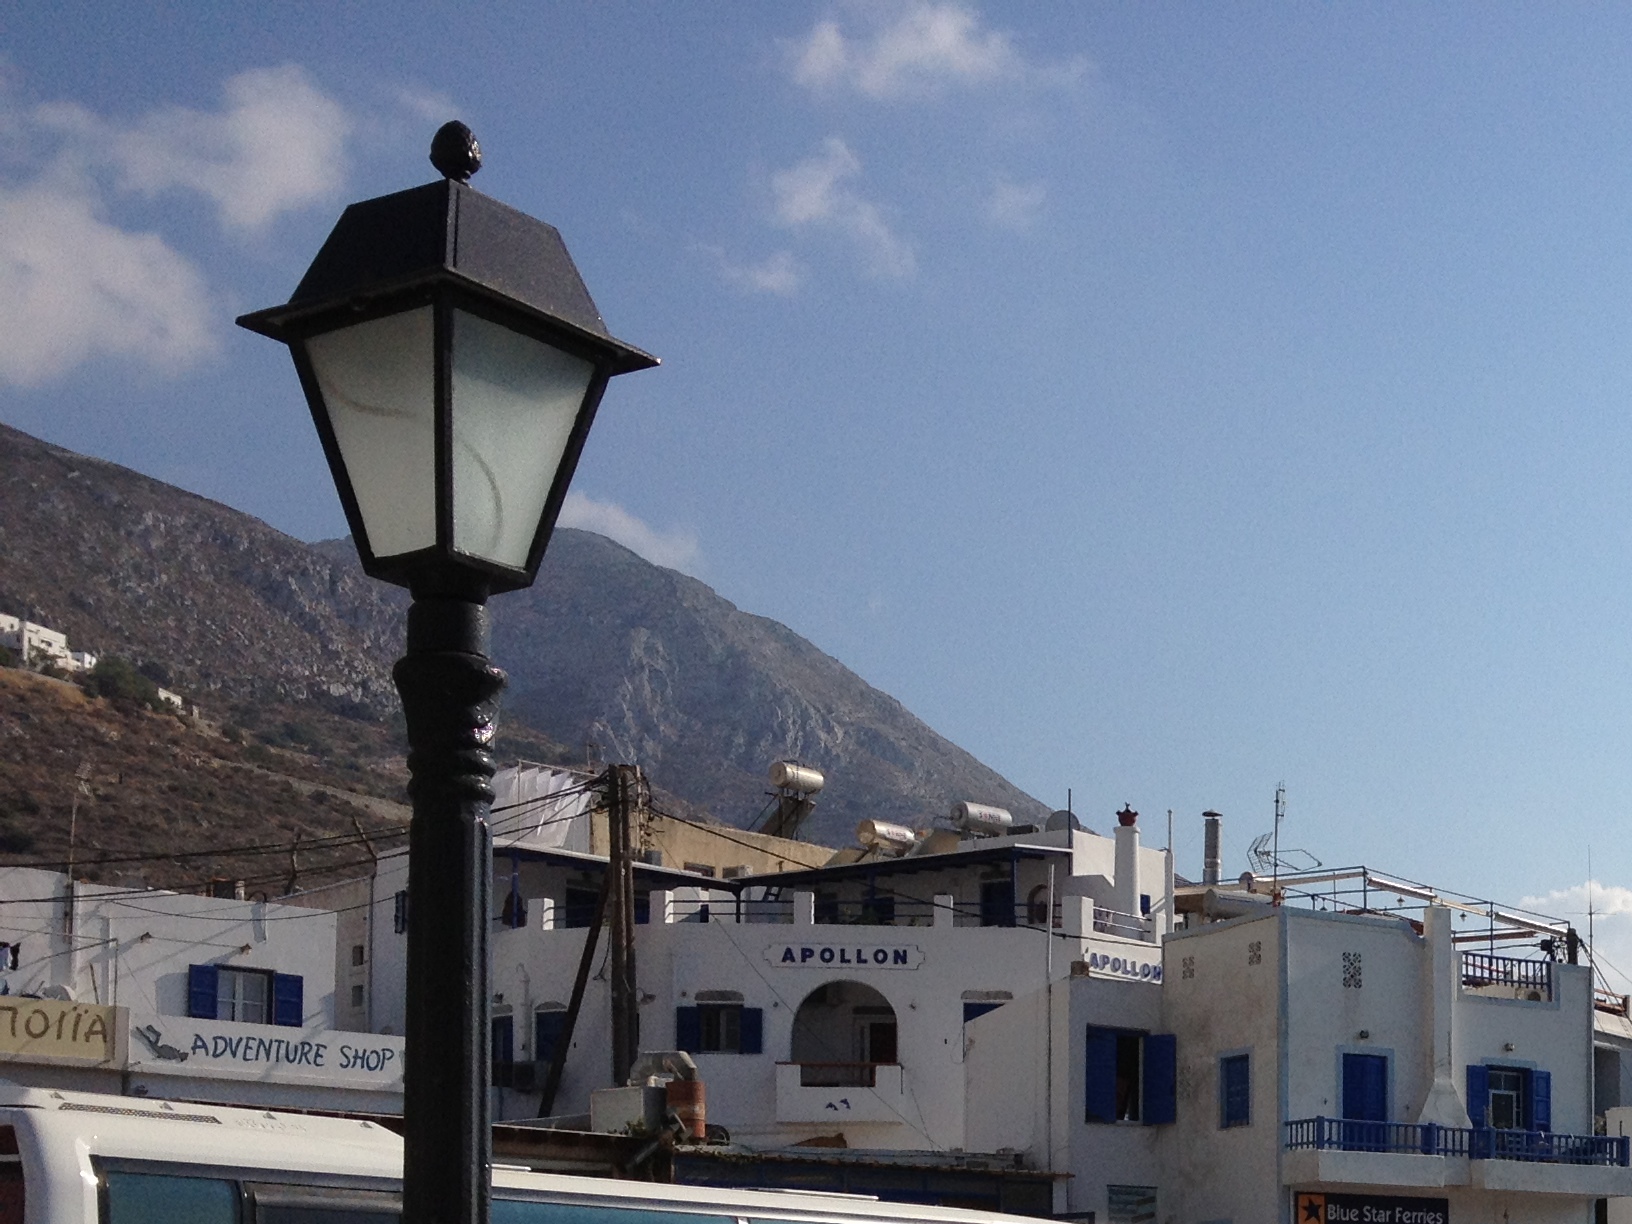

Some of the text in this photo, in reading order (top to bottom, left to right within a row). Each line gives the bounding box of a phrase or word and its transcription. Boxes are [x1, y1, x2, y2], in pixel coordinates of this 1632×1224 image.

[781, 947, 908, 965] APOLLON
[1089, 952, 1162, 981] APOLLON
[191, 1033, 395, 1071] ADVENTURE SHOP
[1327, 1204, 1444, 1224] Blue Star Ferries
